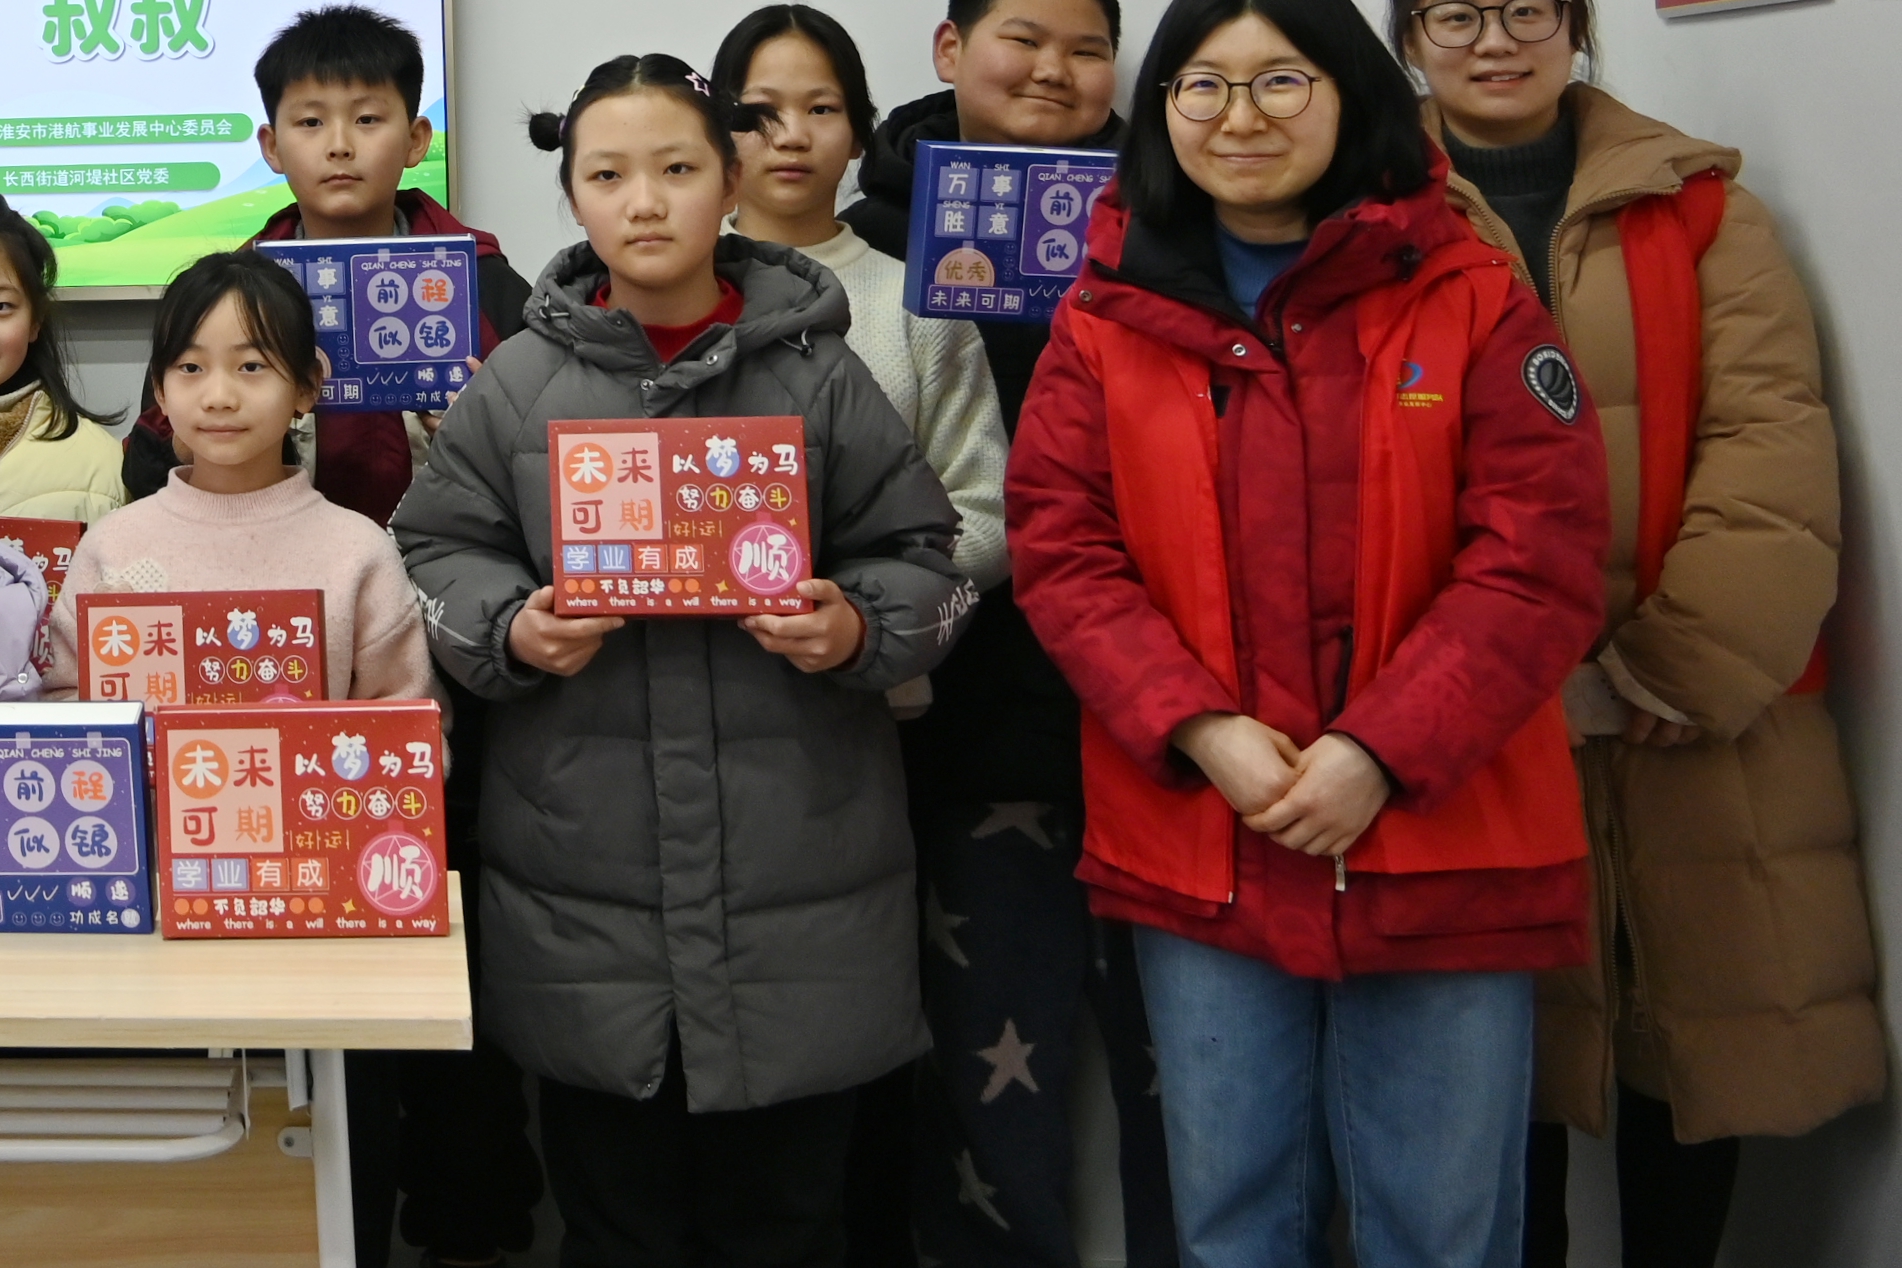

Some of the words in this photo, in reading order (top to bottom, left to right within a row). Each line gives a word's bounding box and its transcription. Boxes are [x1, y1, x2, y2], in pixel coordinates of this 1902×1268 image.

[2, 167, 170, 188] 长西街道河堤社区党委
[1038, 173, 1061, 181] QIAN
[1067, 174, 1094, 182] CHENG
[944, 261, 986, 281] 优秀
[376, 278, 448, 304] 前程
[932, 291, 1020, 310] 未来可期
[570, 447, 654, 484] 未来
[672, 436, 798, 477] 以梦为马
[680, 486, 787, 509] 努力奋斗
[571, 499, 654, 534] 可期
[567, 546, 698, 570] 学业有成
[567, 598, 598, 606] where
[610, 597, 636, 606] there
[683, 597, 699, 606] will
[711, 597, 738, 606] there
[780, 598, 802, 609] way
[98, 620, 178, 657] 未来
[196, 609, 314, 650] 以梦为马
[202, 659, 303, 682] 努力奋斗
[99, 671, 178, 703] 可期
[31, 749, 64, 757] CHENG
[72, 749, 90, 757] SHI
[96, 749, 122, 757] JING
[295, 732, 434, 780] 以梦为马
[180, 745, 274, 788] 未来
[14, 769, 106, 801] 前程
[303, 791, 421, 817] 努力奋斗
[181, 805, 274, 846] 可期
[177, 860, 323, 888] 学业有成
[177, 920, 211, 929] where
[224, 918, 253, 929] there
[306, 919, 323, 929] will
[336, 918, 366, 928] there
[412, 919, 436, 931] way
